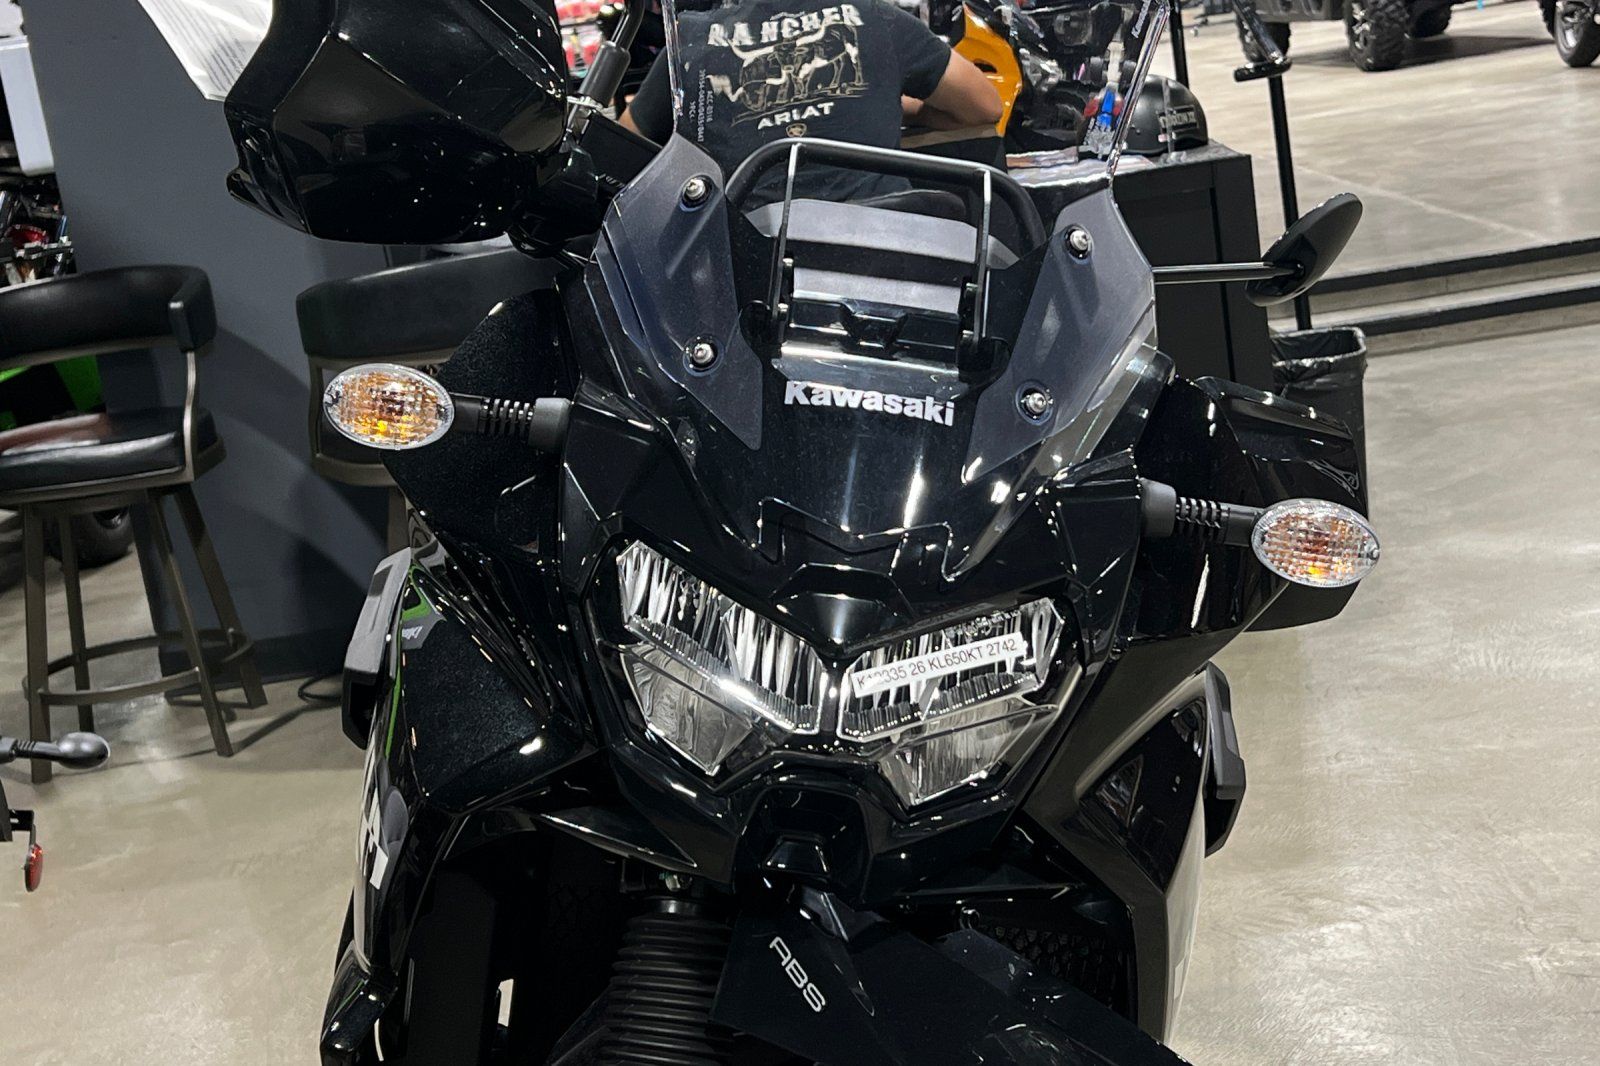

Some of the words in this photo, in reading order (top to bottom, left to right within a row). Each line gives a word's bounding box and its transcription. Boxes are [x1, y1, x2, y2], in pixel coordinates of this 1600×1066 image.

[707, 4, 865, 47] RANCHER
[757, 102, 835, 130] ARIAT
[784, 380, 955, 427] Kawasaki
[910, 660, 927, 677] 26
[928, 644, 985, 672] KL650KT
[985, 639, 1018, 657] 2742
[769, 936, 826, 1013] ABS
